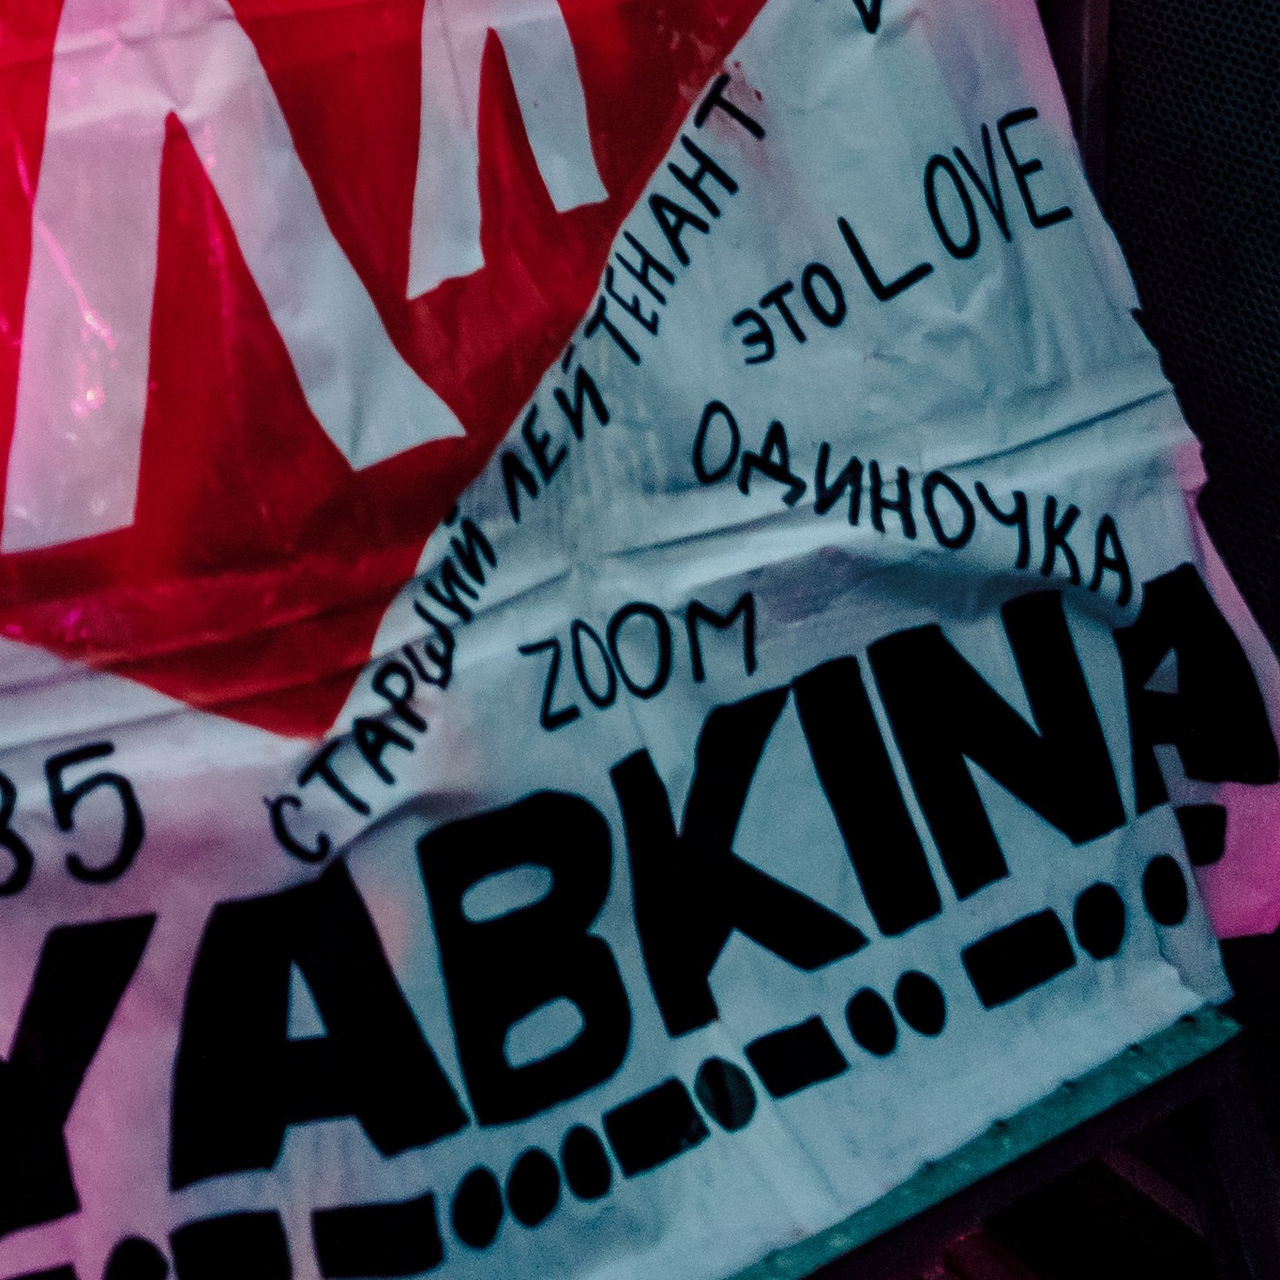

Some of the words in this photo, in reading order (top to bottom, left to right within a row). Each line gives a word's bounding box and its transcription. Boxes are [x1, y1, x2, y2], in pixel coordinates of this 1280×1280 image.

[731, 261, 848, 366] ЭТО
[836, 107, 1074, 303] LOVE
[691, 400, 1134, 607] ОДИНОЧКА
[264, 504, 498, 865] СТАРШИЙ
[518, 590, 759, 732] ZOOM
